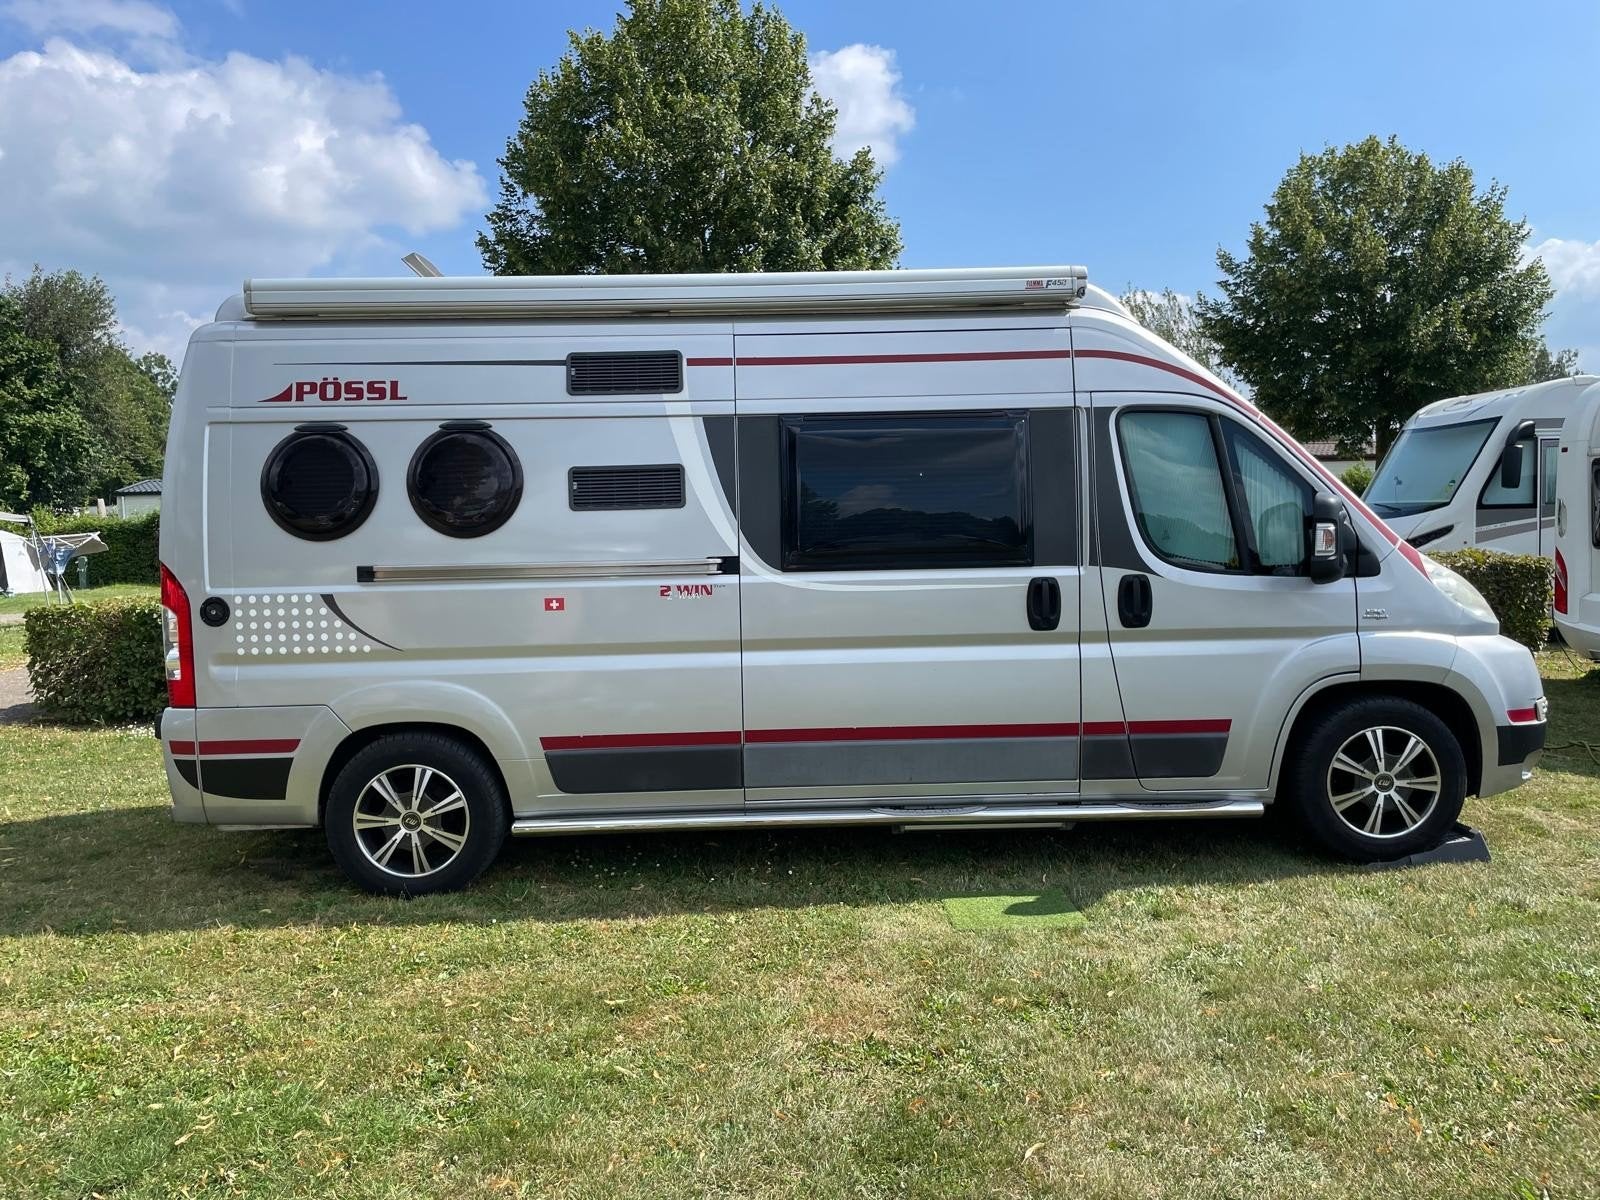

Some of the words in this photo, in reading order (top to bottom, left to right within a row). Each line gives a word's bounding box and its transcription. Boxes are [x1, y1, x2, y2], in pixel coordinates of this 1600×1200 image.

[295, 377, 408, 402] PÖSSL
[660, 585, 672, 597] 2
[676, 584, 713, 597] WIN
